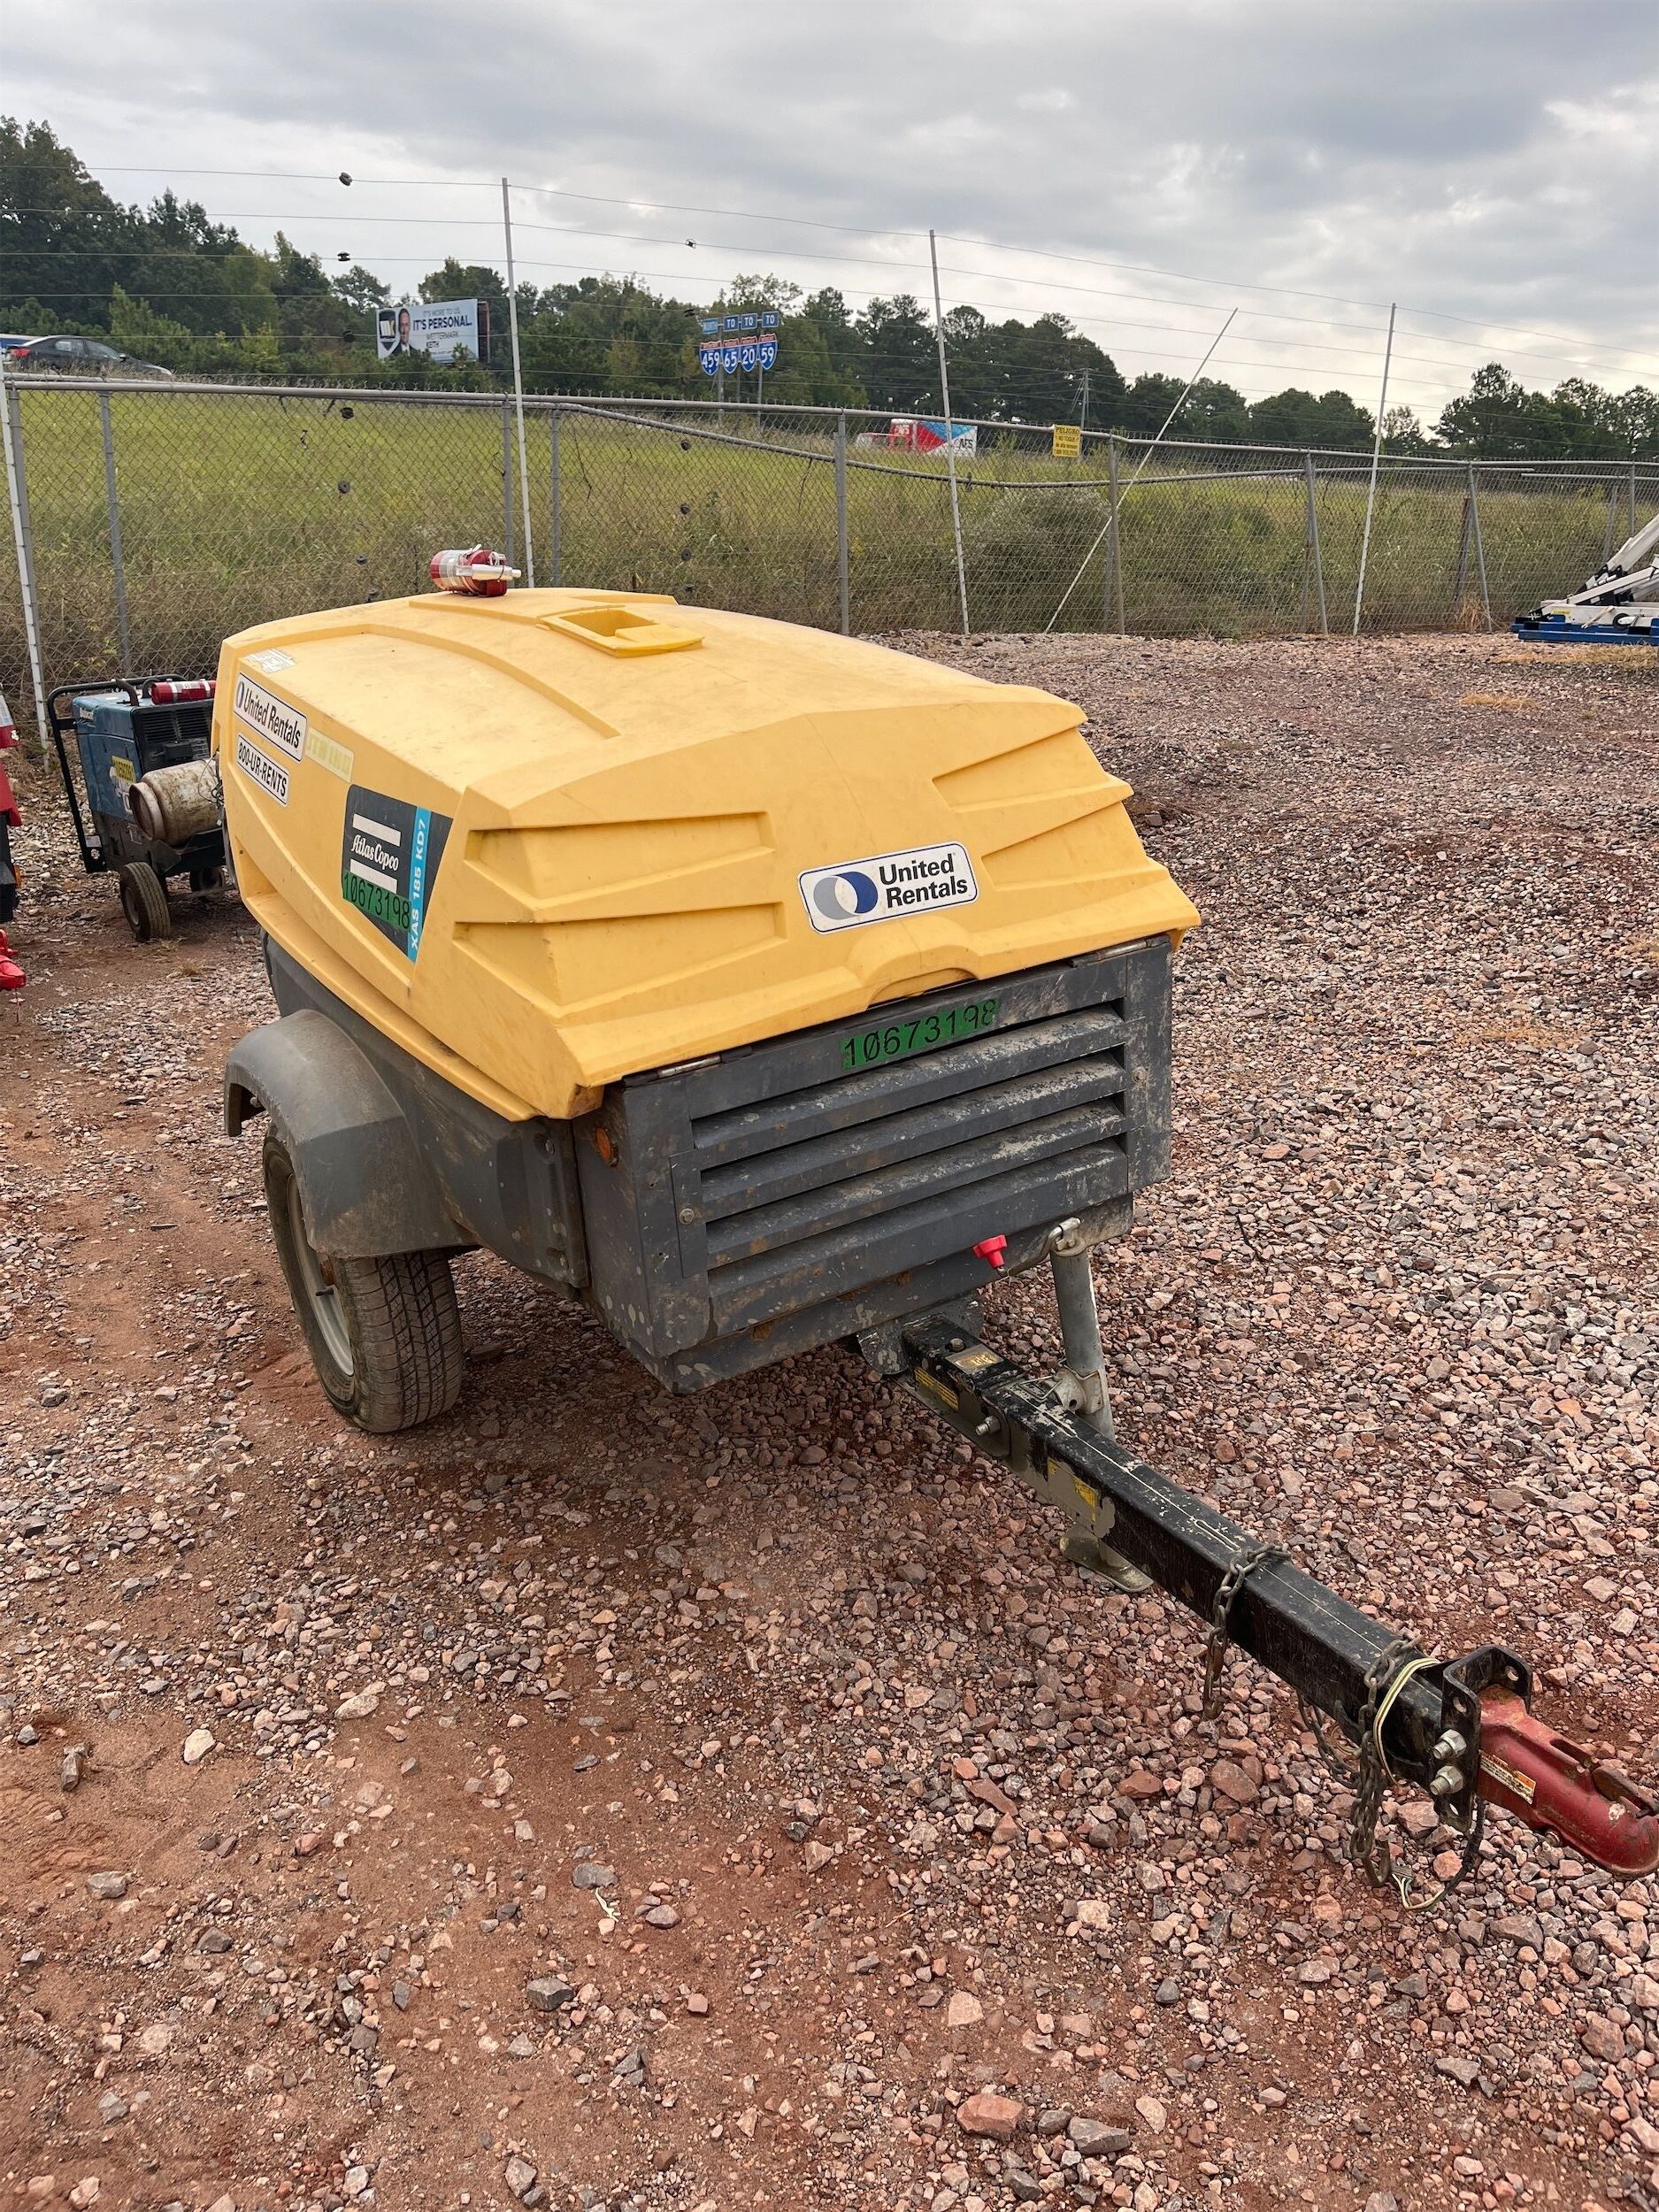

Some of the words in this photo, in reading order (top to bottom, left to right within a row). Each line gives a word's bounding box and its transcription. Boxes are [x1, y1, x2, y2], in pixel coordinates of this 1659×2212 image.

[413, 319, 427, 331] IT'S
[428, 314, 472, 330] PERSONAL.
[726, 319, 736, 328] TO
[744, 317, 754, 326] TO
[765, 315, 775, 325] TO
[702, 351, 719, 369] 459
[725, 351, 737, 368] 65
[742, 348, 756, 365] 20
[761, 346, 774, 364] 59
[1056, 427, 1079, 436] PELIGRO
[243, 687, 270, 726] United
[267, 705, 301, 749] Rentals
[238, 741, 288, 797] 800-UR-RENTS
[351, 834, 375, 861] Atlas
[374, 843, 399, 872] Copco
[416, 818, 426, 860] KD7
[413, 867, 422, 899] 185
[879, 853, 955, 886] United
[343, 872, 411, 930] 10673198
[886, 875, 968, 909] Rentals
[411, 910, 419, 950] XAS
[843, 998, 997, 1067] 10673198
